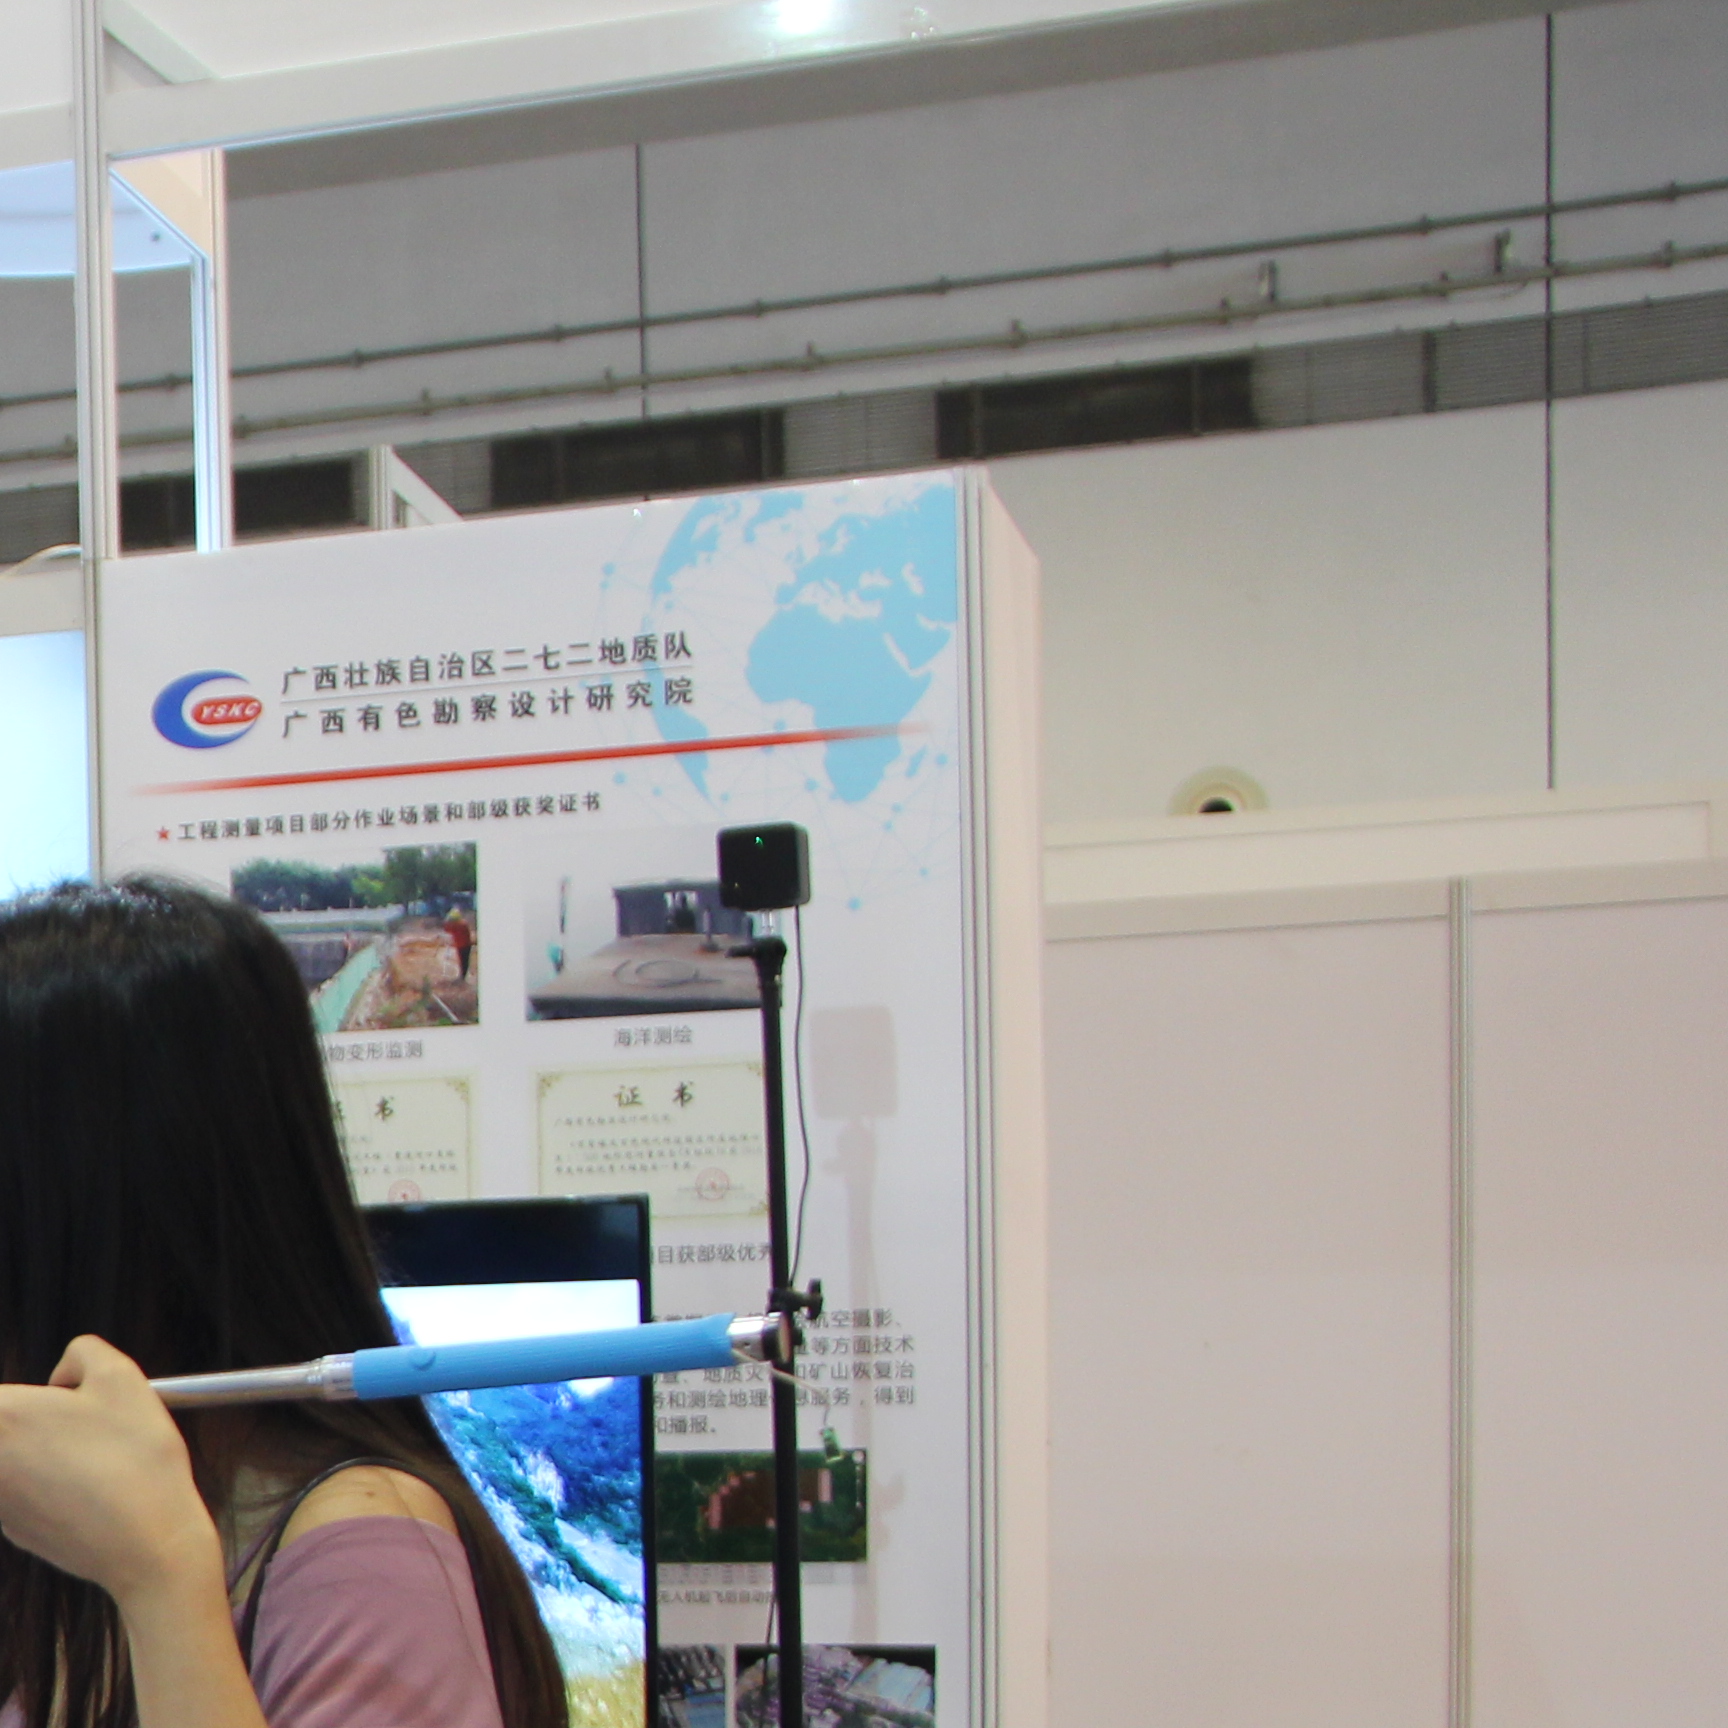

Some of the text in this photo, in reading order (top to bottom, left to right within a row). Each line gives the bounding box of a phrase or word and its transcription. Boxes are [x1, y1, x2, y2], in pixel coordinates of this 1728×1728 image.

[282, 631, 692, 695] 广西壮族自治区二七二地质队
[199, 700, 260, 720] YSKC
[282, 677, 692, 738] 广西有色勘察设计研究院
[177, 791, 600, 841] 工程测量项目部分作业场景和部级获奖证书
[614, 1024, 694, 1047] 海洋测绘
[613, 1080, 696, 1108] 证书
